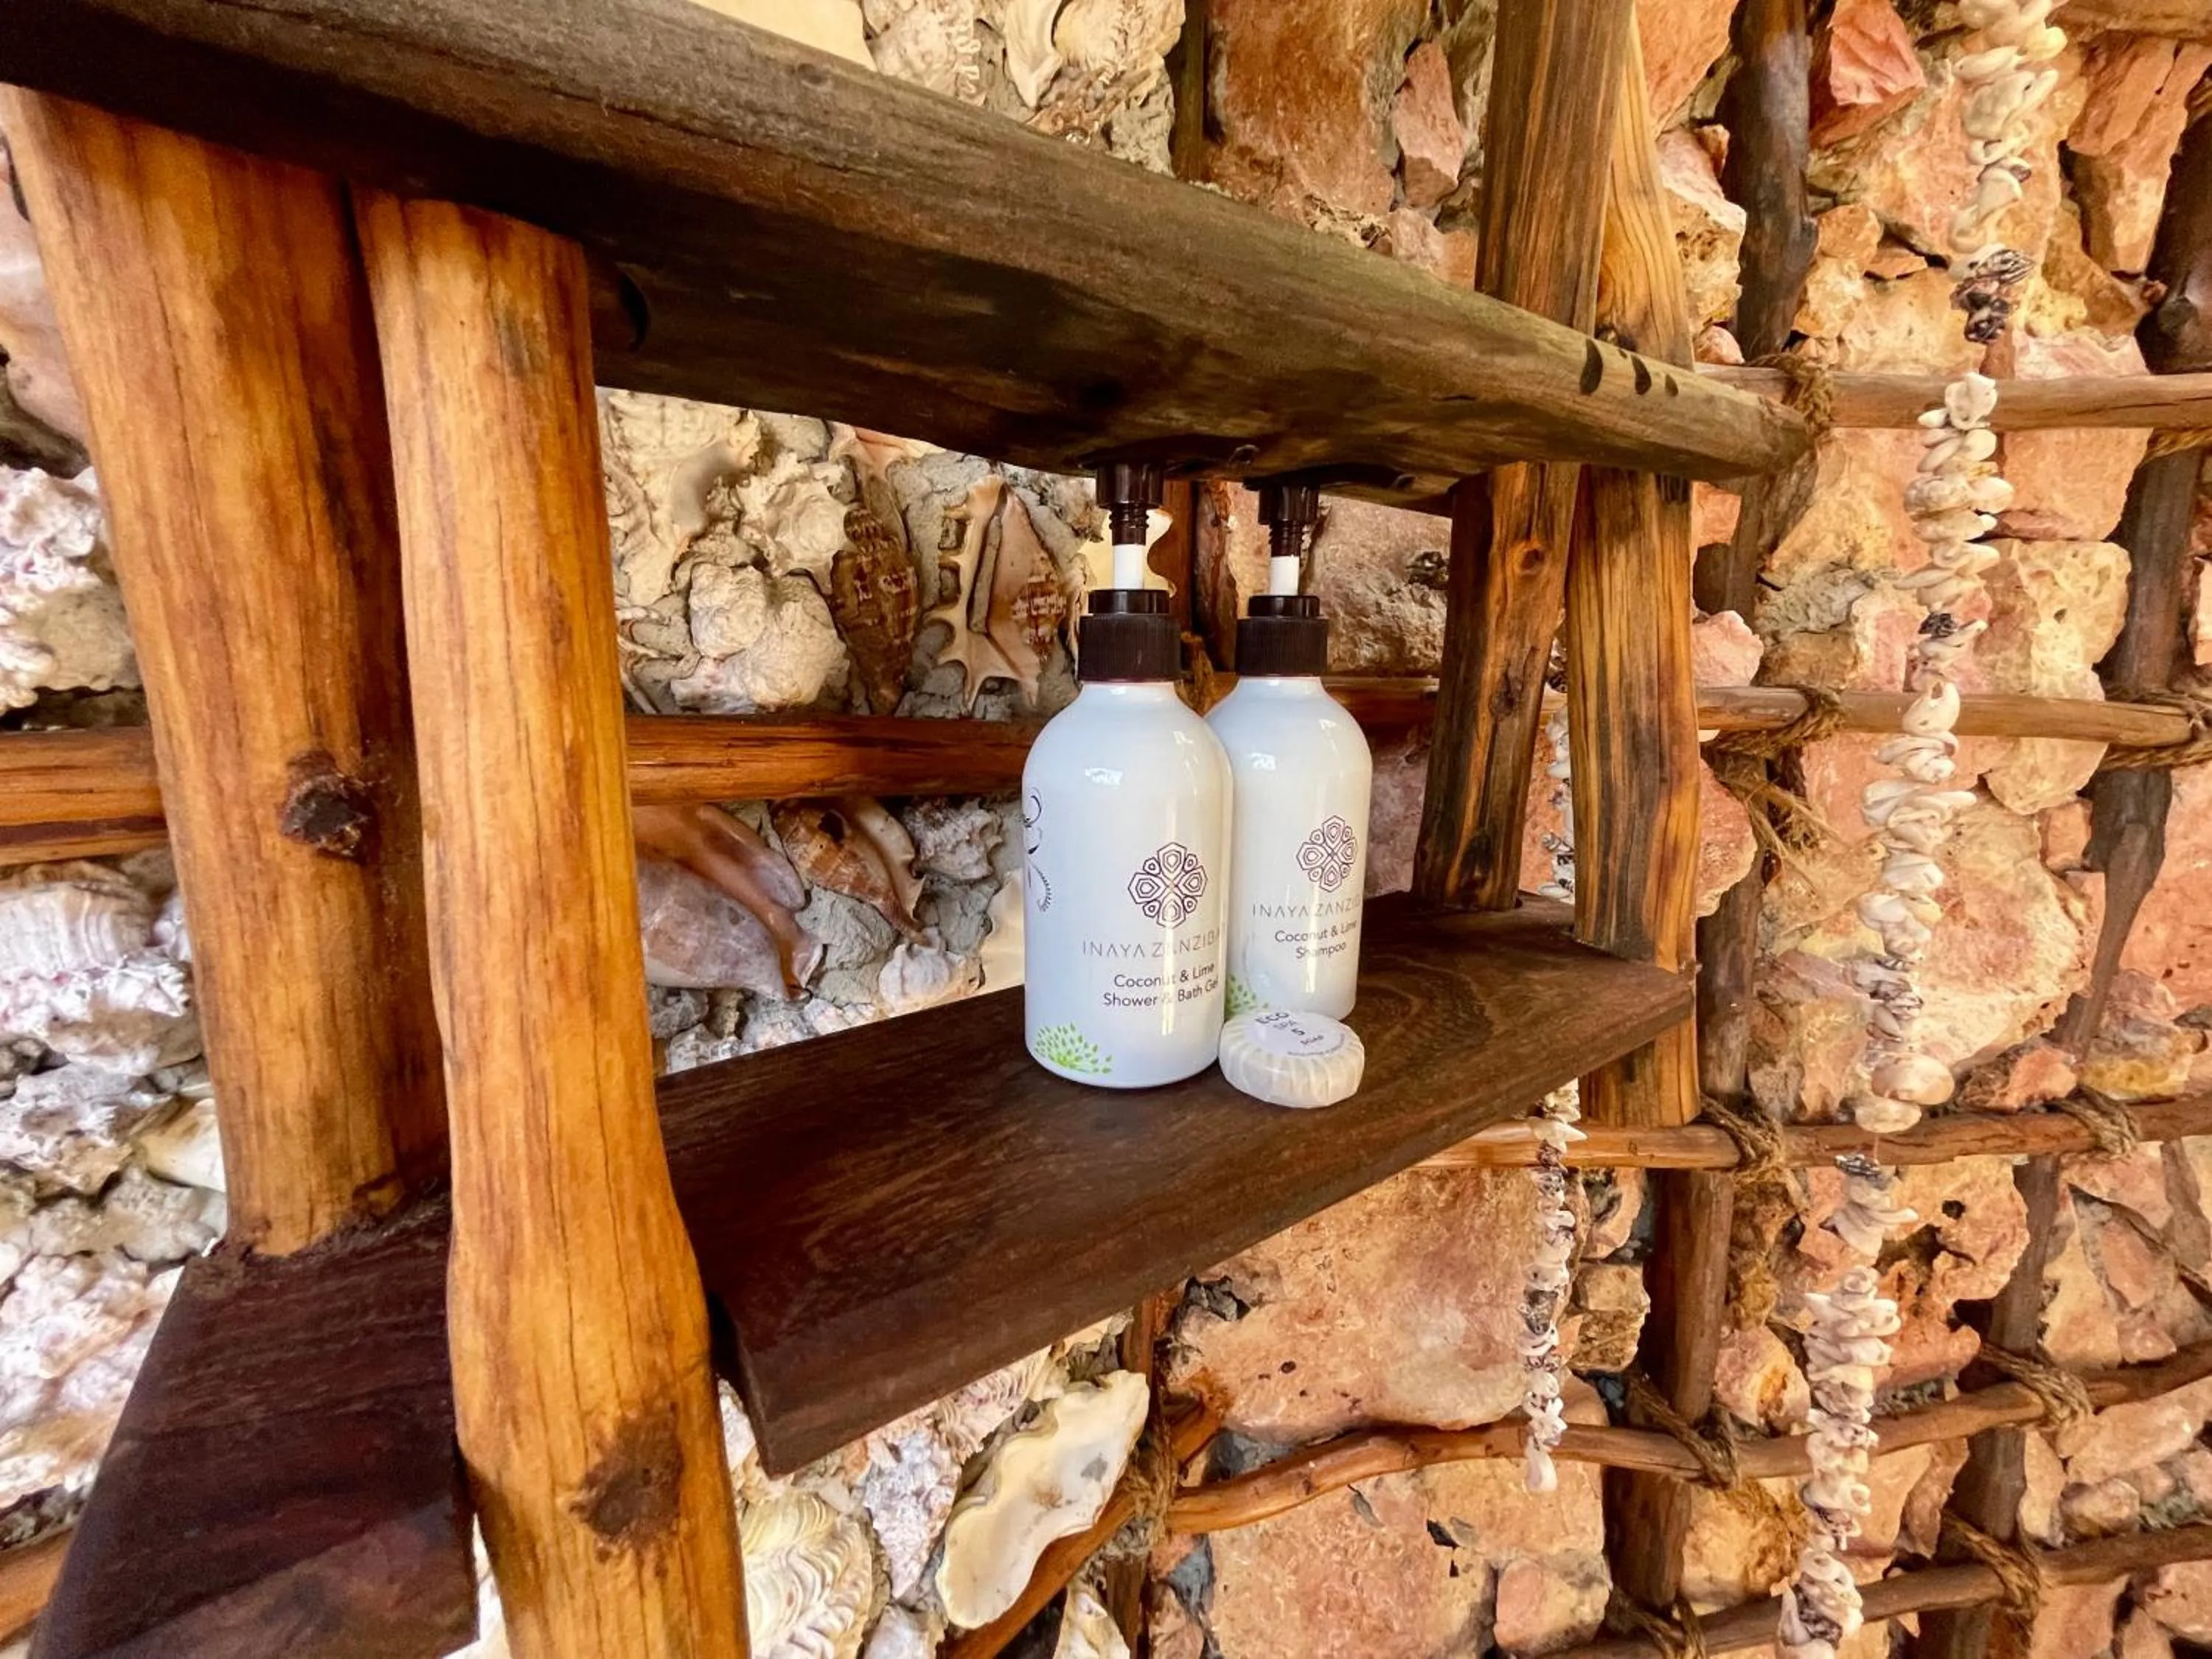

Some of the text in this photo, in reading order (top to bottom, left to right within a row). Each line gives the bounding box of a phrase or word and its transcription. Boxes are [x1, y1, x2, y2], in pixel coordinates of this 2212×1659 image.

[1253, 902, 1309, 919] INAYA
[1274, 929, 1328, 943] Coconut
[1082, 940, 1146, 959] INAYA
[1113, 962, 1215, 988] Coconut & Lime
[1102, 992, 1158, 1006] Shower
[1177, 984, 1203, 1003] Bath
